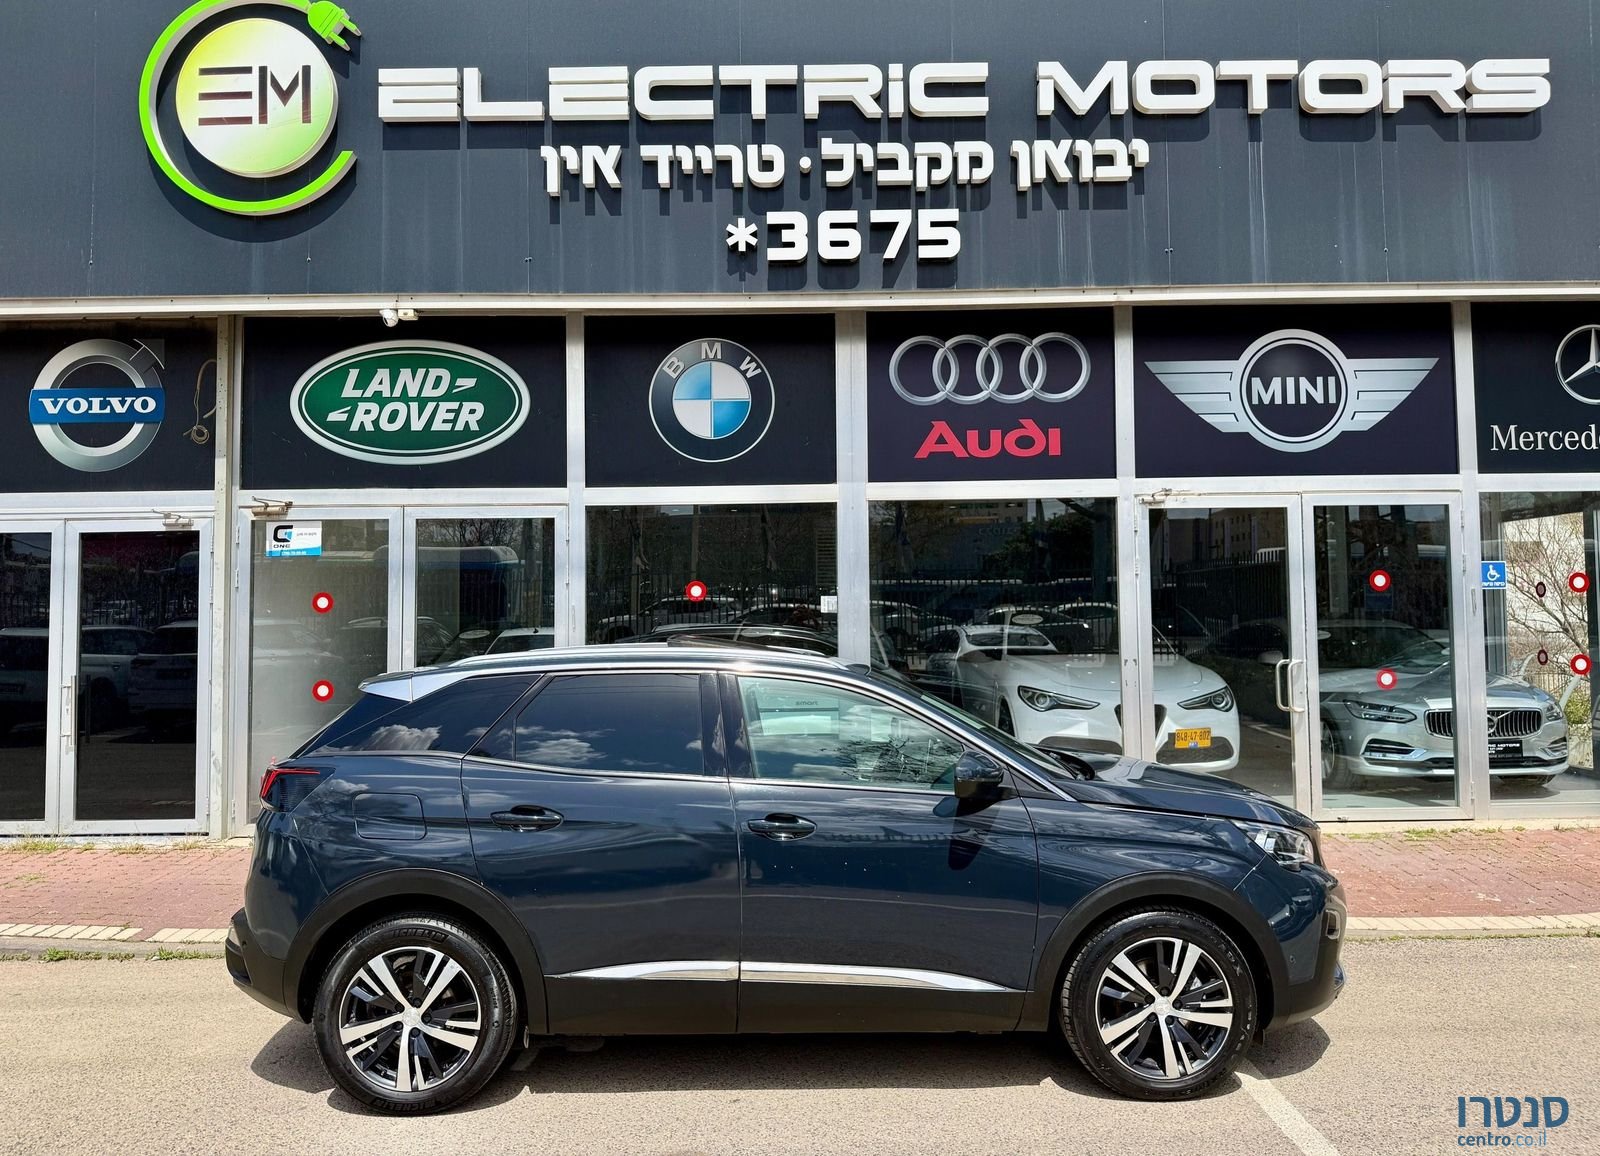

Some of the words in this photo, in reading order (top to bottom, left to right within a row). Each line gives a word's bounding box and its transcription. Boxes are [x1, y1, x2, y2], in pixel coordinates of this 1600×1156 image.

[199, 65, 311, 126] EM
[1036, 58, 1551, 116] MOTORS
[540, 145, 622, 197] אין
[640, 144, 785, 188] טרייד
[821, 137, 994, 191] מקביל
[1010, 138, 1150, 191] יבואן
[662, 342, 762, 379] BMW
[341, 368, 450, 398] LAND
[1251, 376, 1337, 405] MINI
[38, 396, 156, 414] VOLVO
[349, 402, 485, 431] ROVER
[914, 418, 1061, 458] Audi
[1490, 424, 1600, 451] Merced
